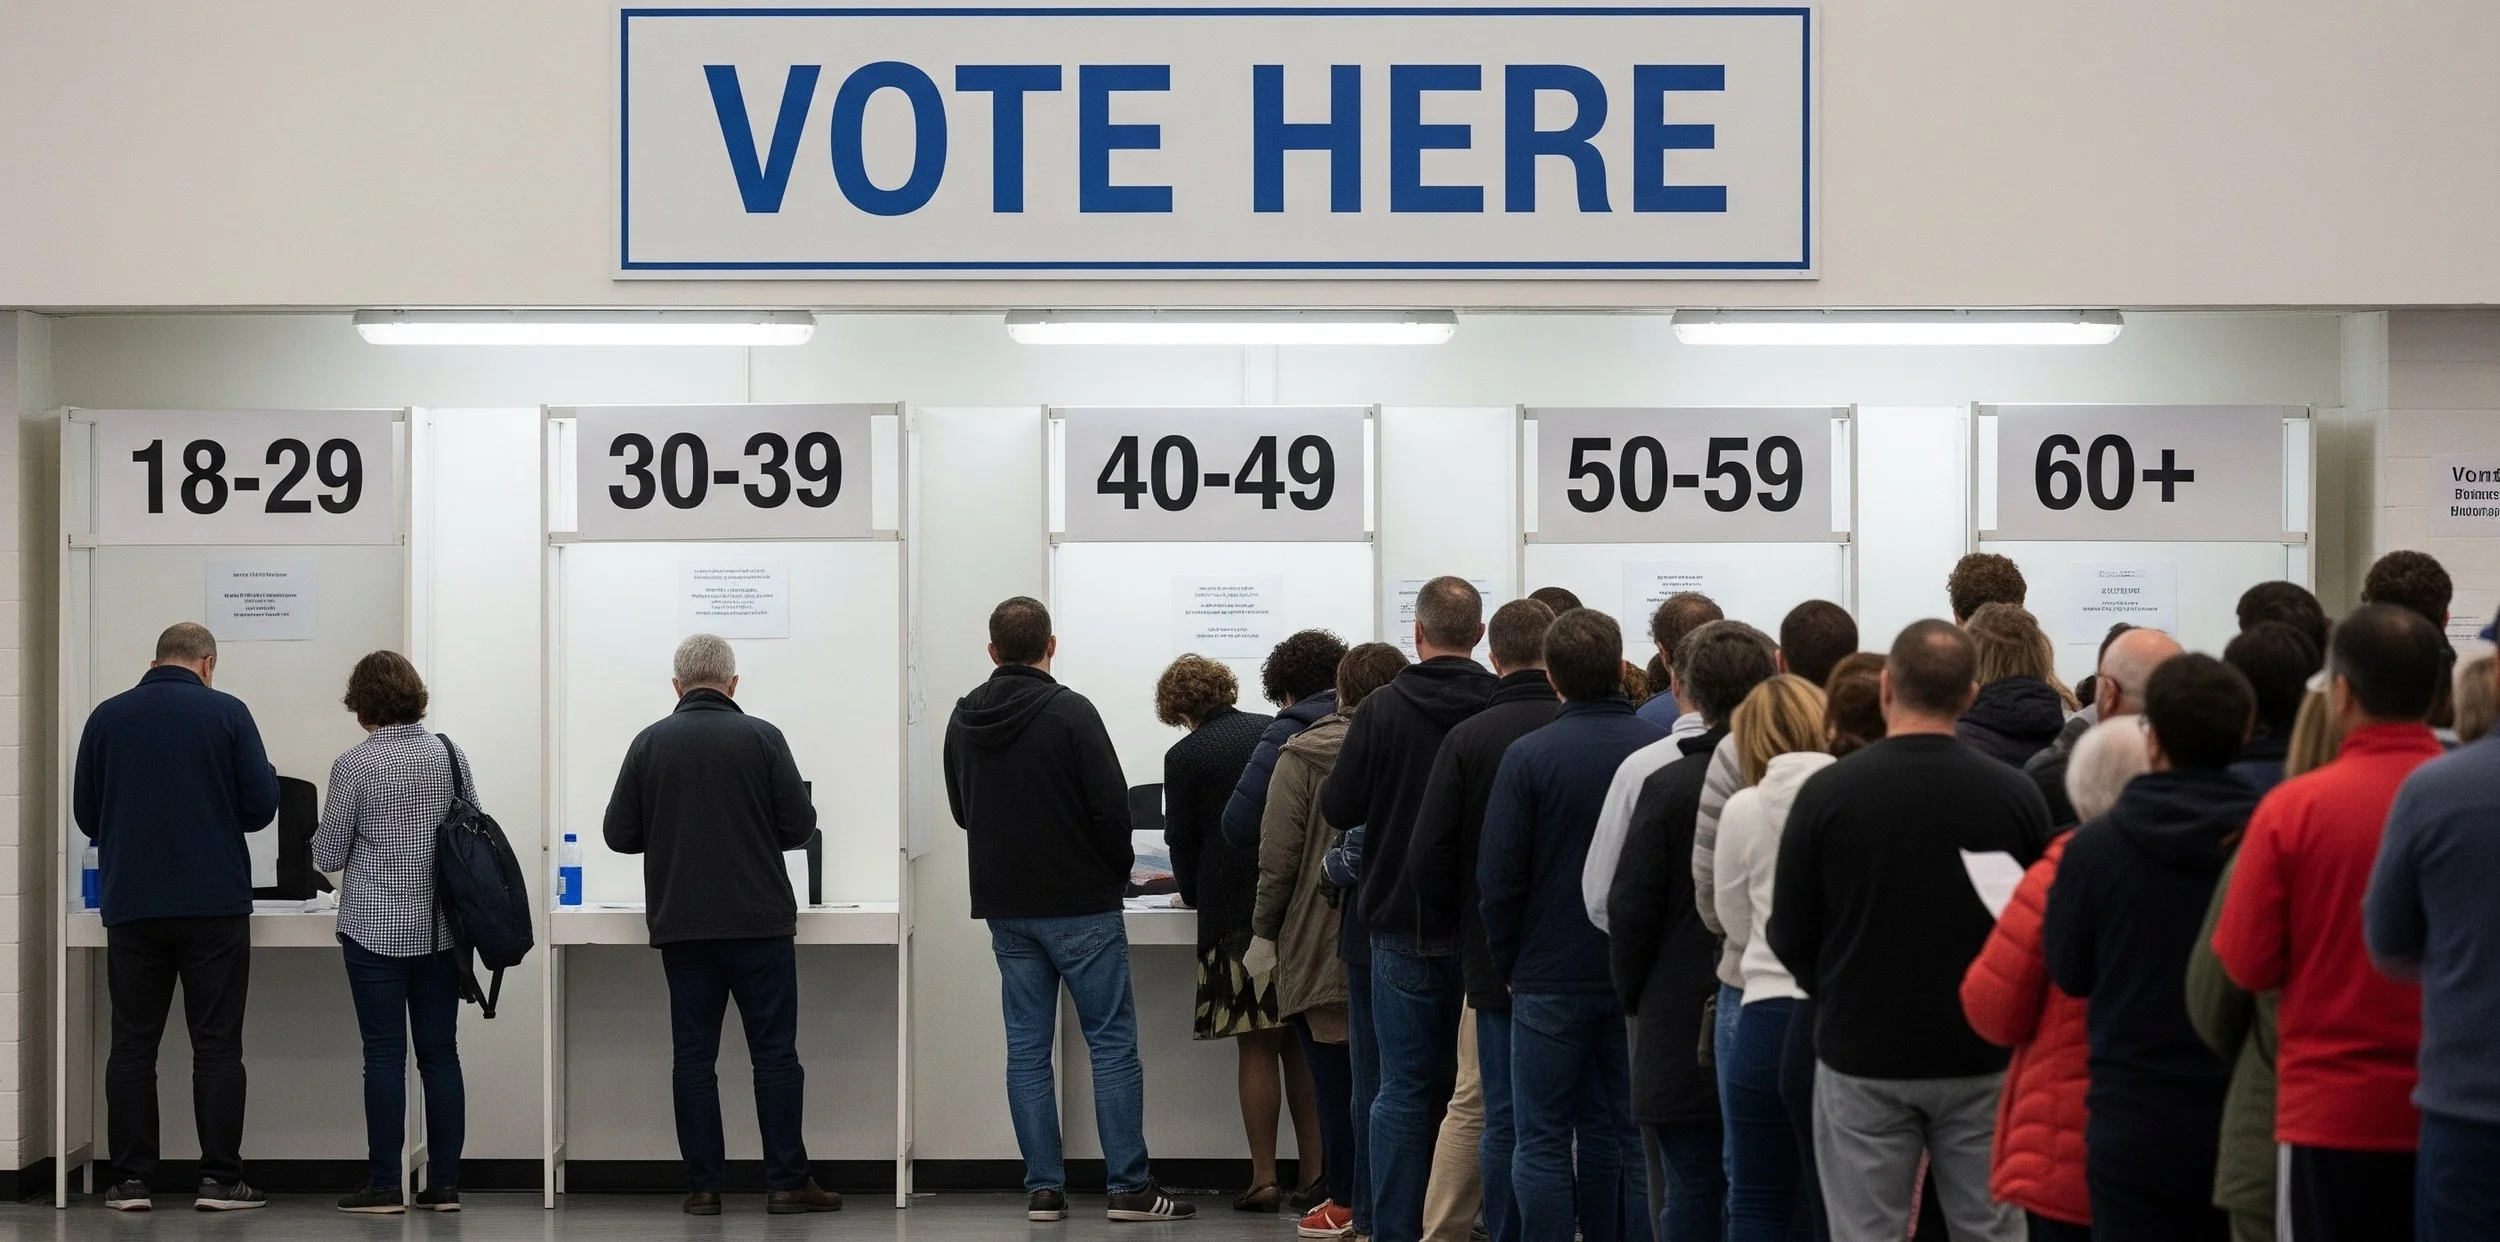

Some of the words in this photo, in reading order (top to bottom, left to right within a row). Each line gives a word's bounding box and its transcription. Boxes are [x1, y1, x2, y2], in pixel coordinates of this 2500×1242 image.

[703, 61, 1172, 216] VOTE
[1253, 65, 1726, 212] HERE
[133, 438, 363, 514] 18-29
[608, 432, 842, 510] 30-39
[1097, 435, 1335, 511] 40-49
[1567, 436, 1803, 512] 50-59
[2035, 434, 2195, 511] 60+
